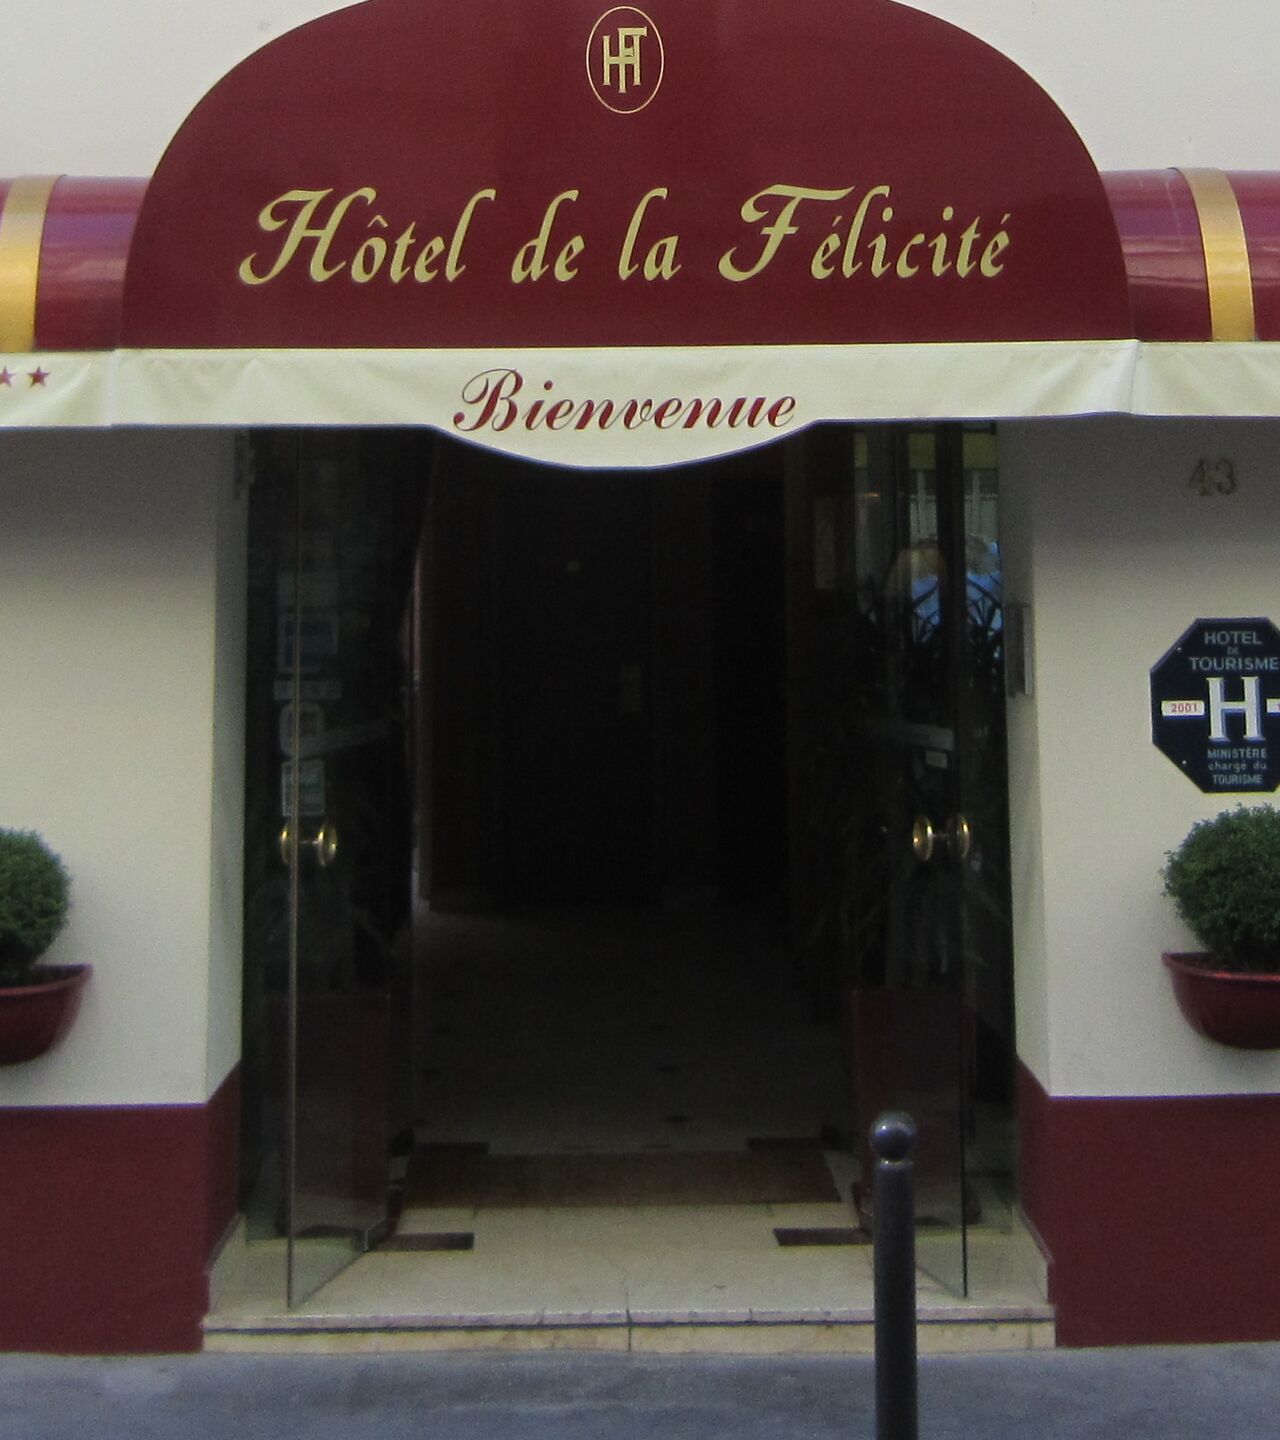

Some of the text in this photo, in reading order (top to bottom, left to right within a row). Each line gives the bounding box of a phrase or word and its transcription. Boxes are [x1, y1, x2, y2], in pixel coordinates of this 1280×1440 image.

[238, 183, 1013, 284] Hôtel de la Félicité
[452, 367, 798, 434] Bienvenue
[1204, 631, 1263, 645] HOTEL
[1227, 647, 1240, 656] DE
[1188, 657, 1280, 671] TOURISME
[1206, 676, 1266, 742] H
[1212, 774, 1263, 785] TOURISME
